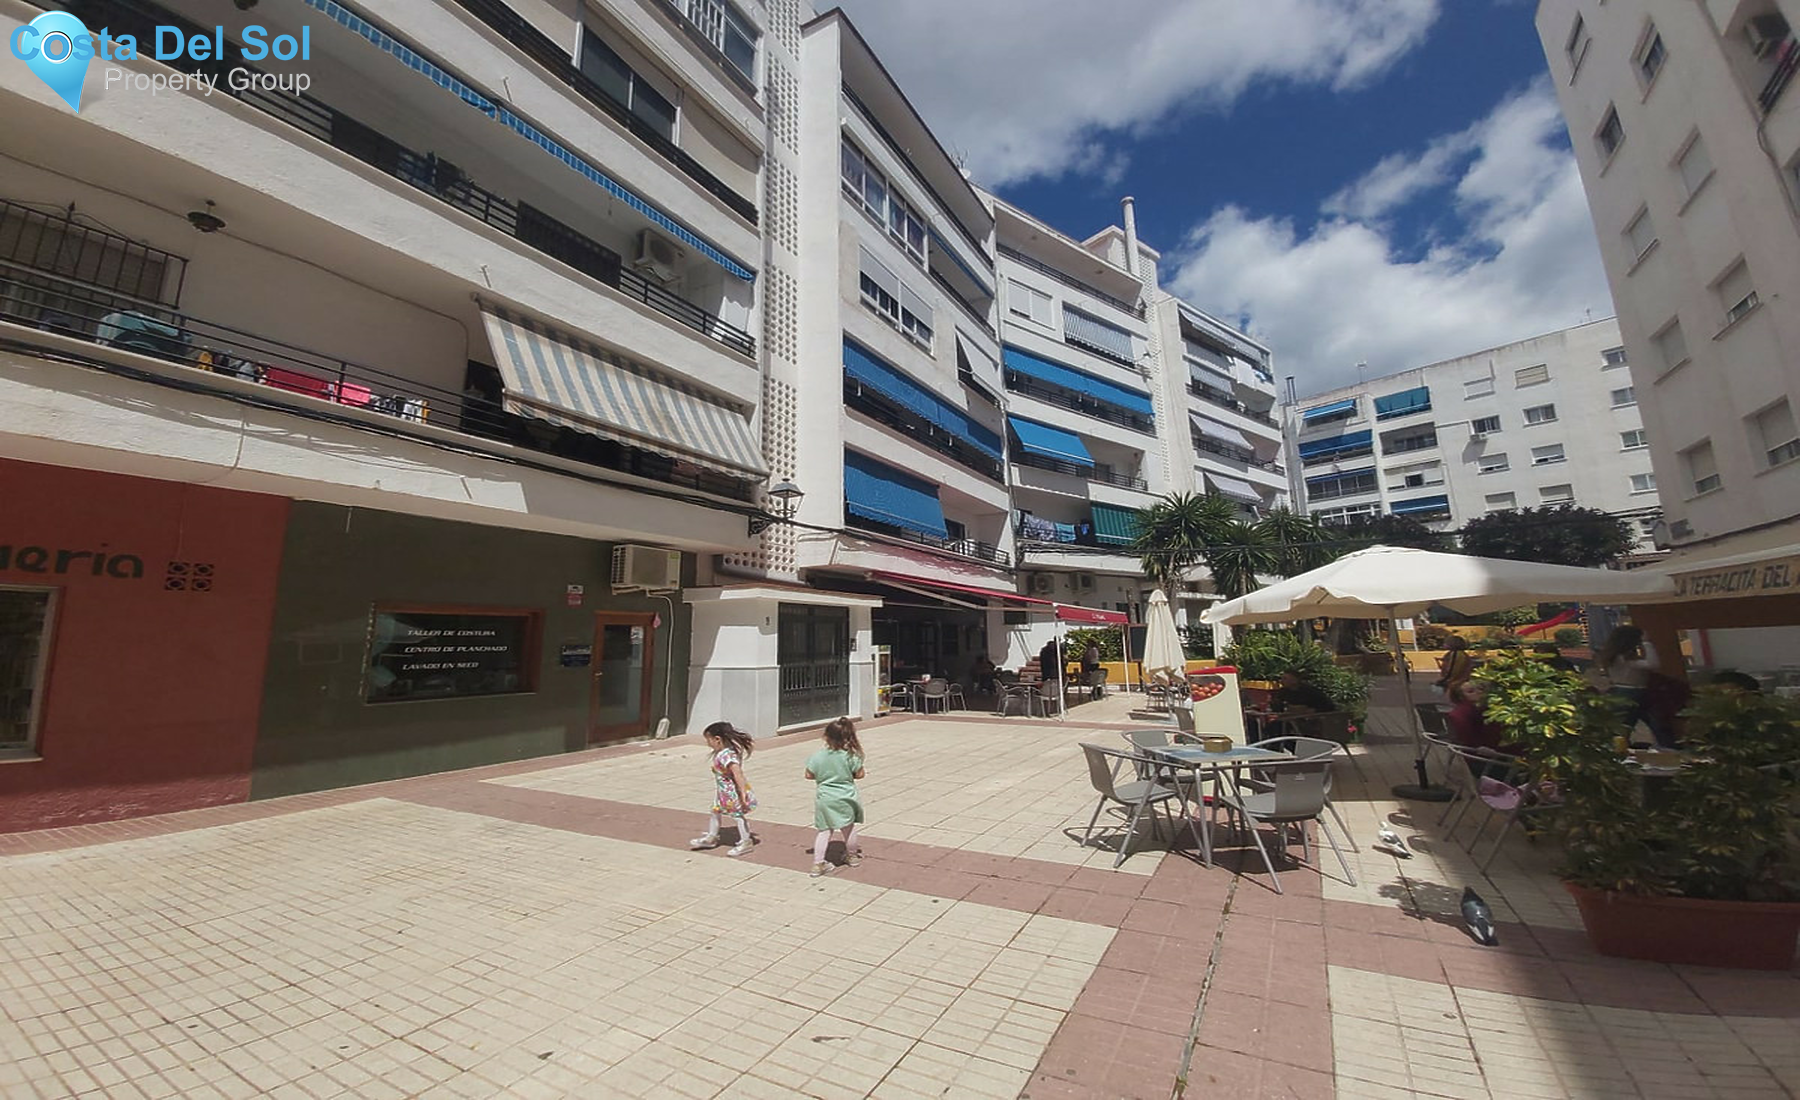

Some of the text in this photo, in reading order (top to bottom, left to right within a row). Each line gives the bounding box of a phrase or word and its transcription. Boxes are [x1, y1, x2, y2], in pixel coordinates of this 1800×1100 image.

[1691, 568, 1758, 596] TERRACITA
[1762, 564, 1791, 589] DEL
[407, 629, 442, 637] TALLER
[443, 629, 456, 637] DE
[404, 646, 442, 654] CENTRO
[457, 645, 508, 653] PLANCHADO
[402, 662, 441, 671] LAVADO
[457, 661, 480, 669] SECO
